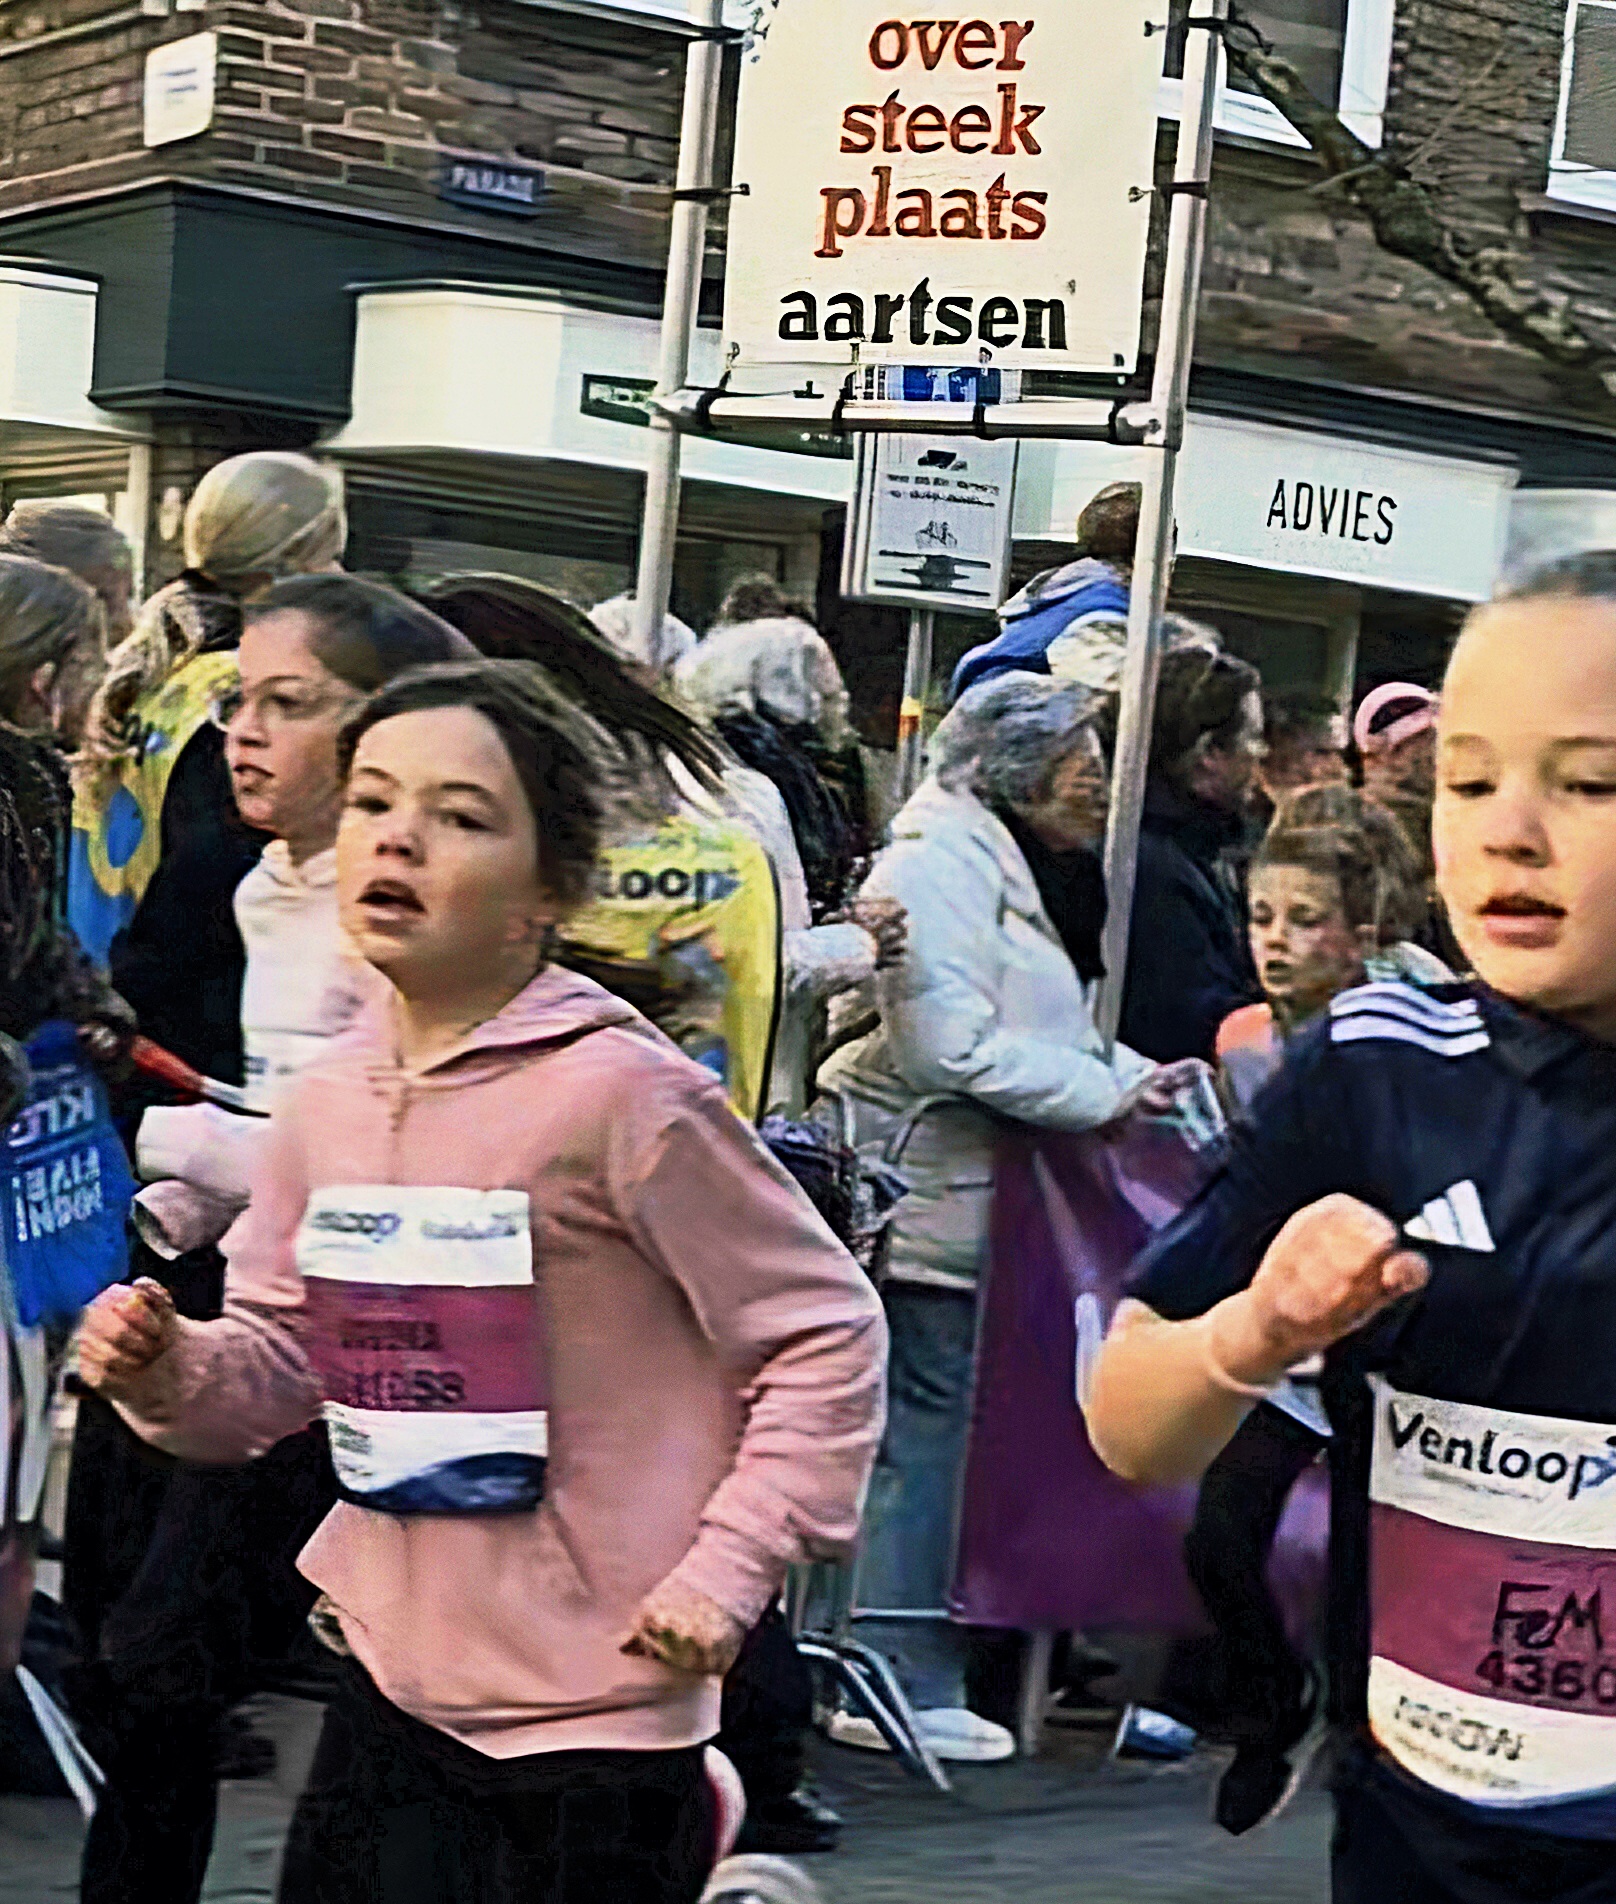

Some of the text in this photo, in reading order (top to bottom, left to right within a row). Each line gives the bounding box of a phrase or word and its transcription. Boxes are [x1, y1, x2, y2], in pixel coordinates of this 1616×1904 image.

[868, 19, 1035, 71] over
[839, 82, 1046, 155] steek
[813, 165, 1049, 258] plaats
[778, 276, 1069, 351] aartsen
[1265, 478, 1398, 546] ADVIES
